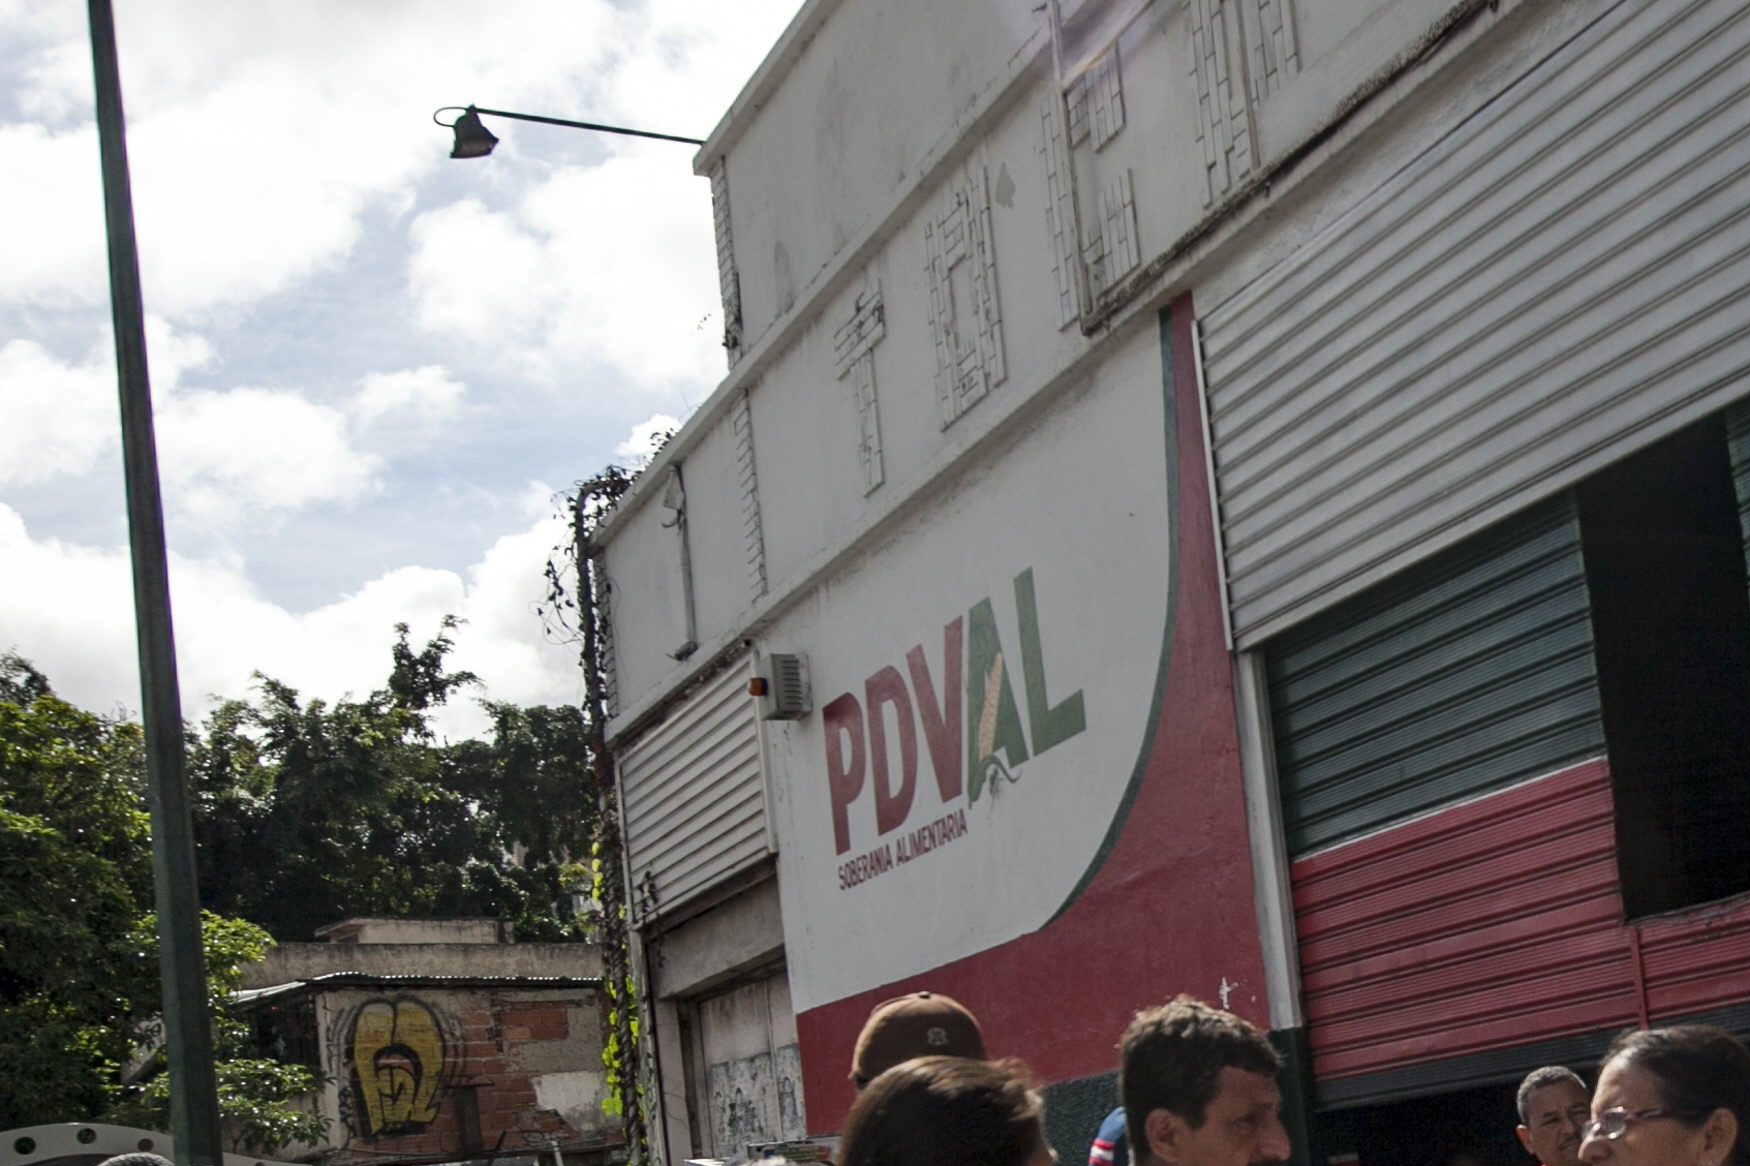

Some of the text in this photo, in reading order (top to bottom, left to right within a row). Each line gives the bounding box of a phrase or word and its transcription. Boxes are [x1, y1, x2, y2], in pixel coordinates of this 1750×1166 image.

[823, 567, 1086, 856] PDVAL
[839, 808, 968, 890] SOBERANIA ALIMENTARIA
